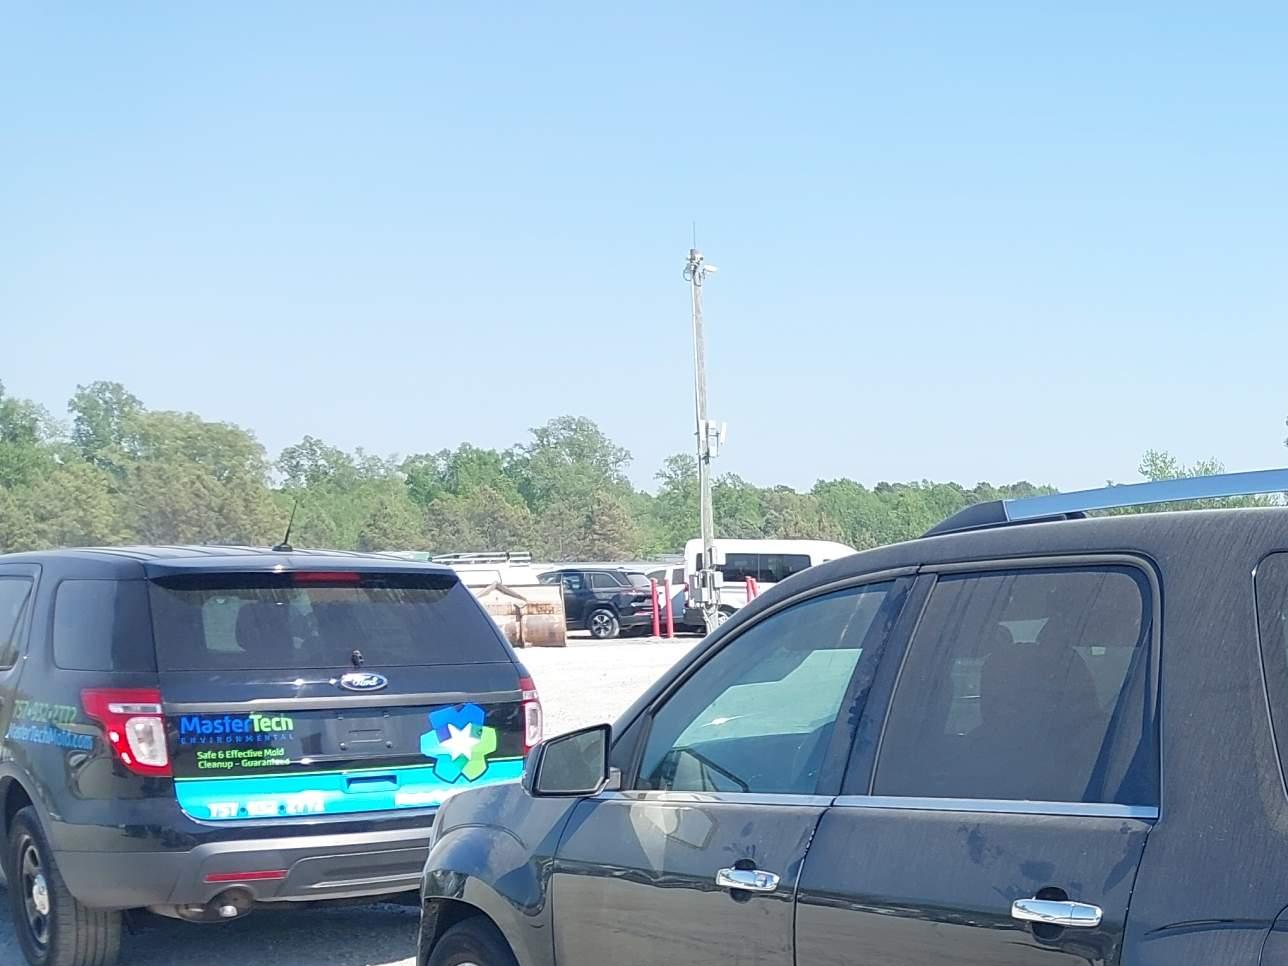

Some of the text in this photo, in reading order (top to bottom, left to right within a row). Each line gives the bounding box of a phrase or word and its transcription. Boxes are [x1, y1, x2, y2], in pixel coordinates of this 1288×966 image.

[180, 713, 294, 734] MasterTech
[181, 733, 295, 745] ENVIRONMENTAL
[197, 750, 217, 760] Safe
[226, 749, 263, 760] Effective
[264, 747, 285, 757] Mold
[198, 760, 234, 770] Cleanup
